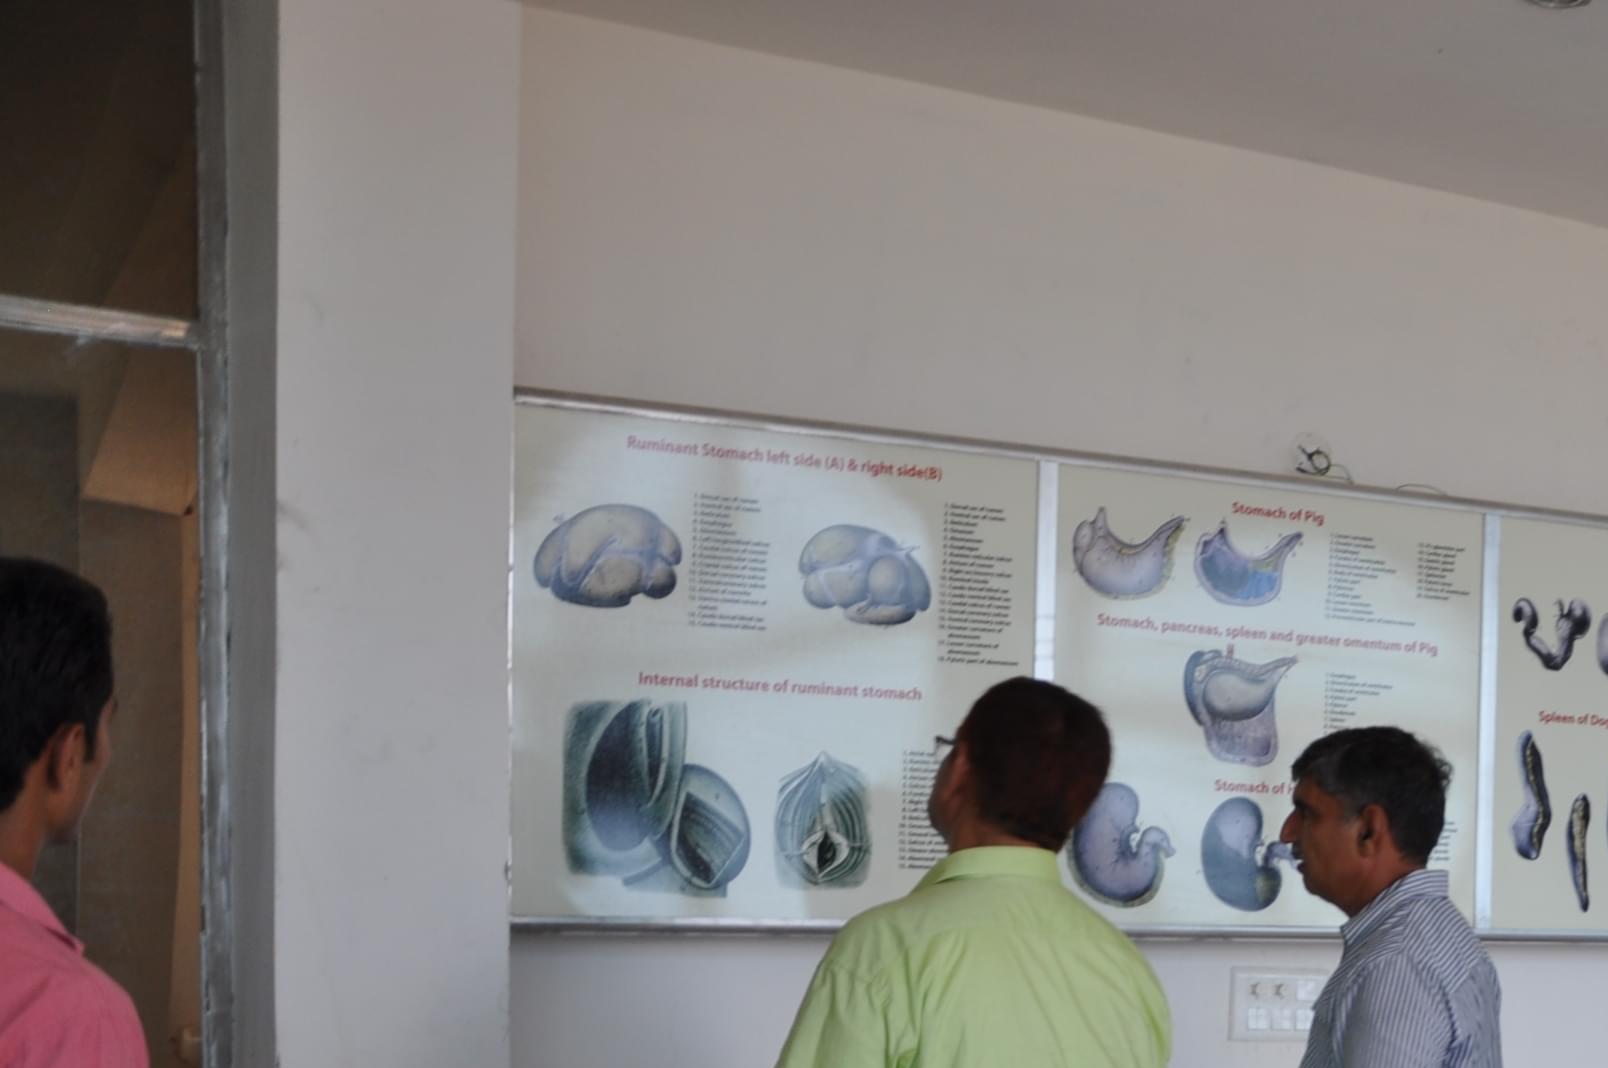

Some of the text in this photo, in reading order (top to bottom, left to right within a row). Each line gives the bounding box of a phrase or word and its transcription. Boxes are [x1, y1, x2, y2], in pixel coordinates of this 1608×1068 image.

[627, 435, 942, 482] Ruminant Stomach left side (A) & right side(B)
[1231, 501, 1325, 527] Stomach of Pig
[1097, 613, 1438, 657] Stomach, pancreas, spleen and greater omentum of Pig
[639, 672, 922, 701] Internal structure of ruminant stomach
[1538, 711, 1575, 727] Spleen
[1577, 713, 1589, 726] of
[1215, 779, 1269, 795] Stomach
[1271, 780, 1285, 795] of
